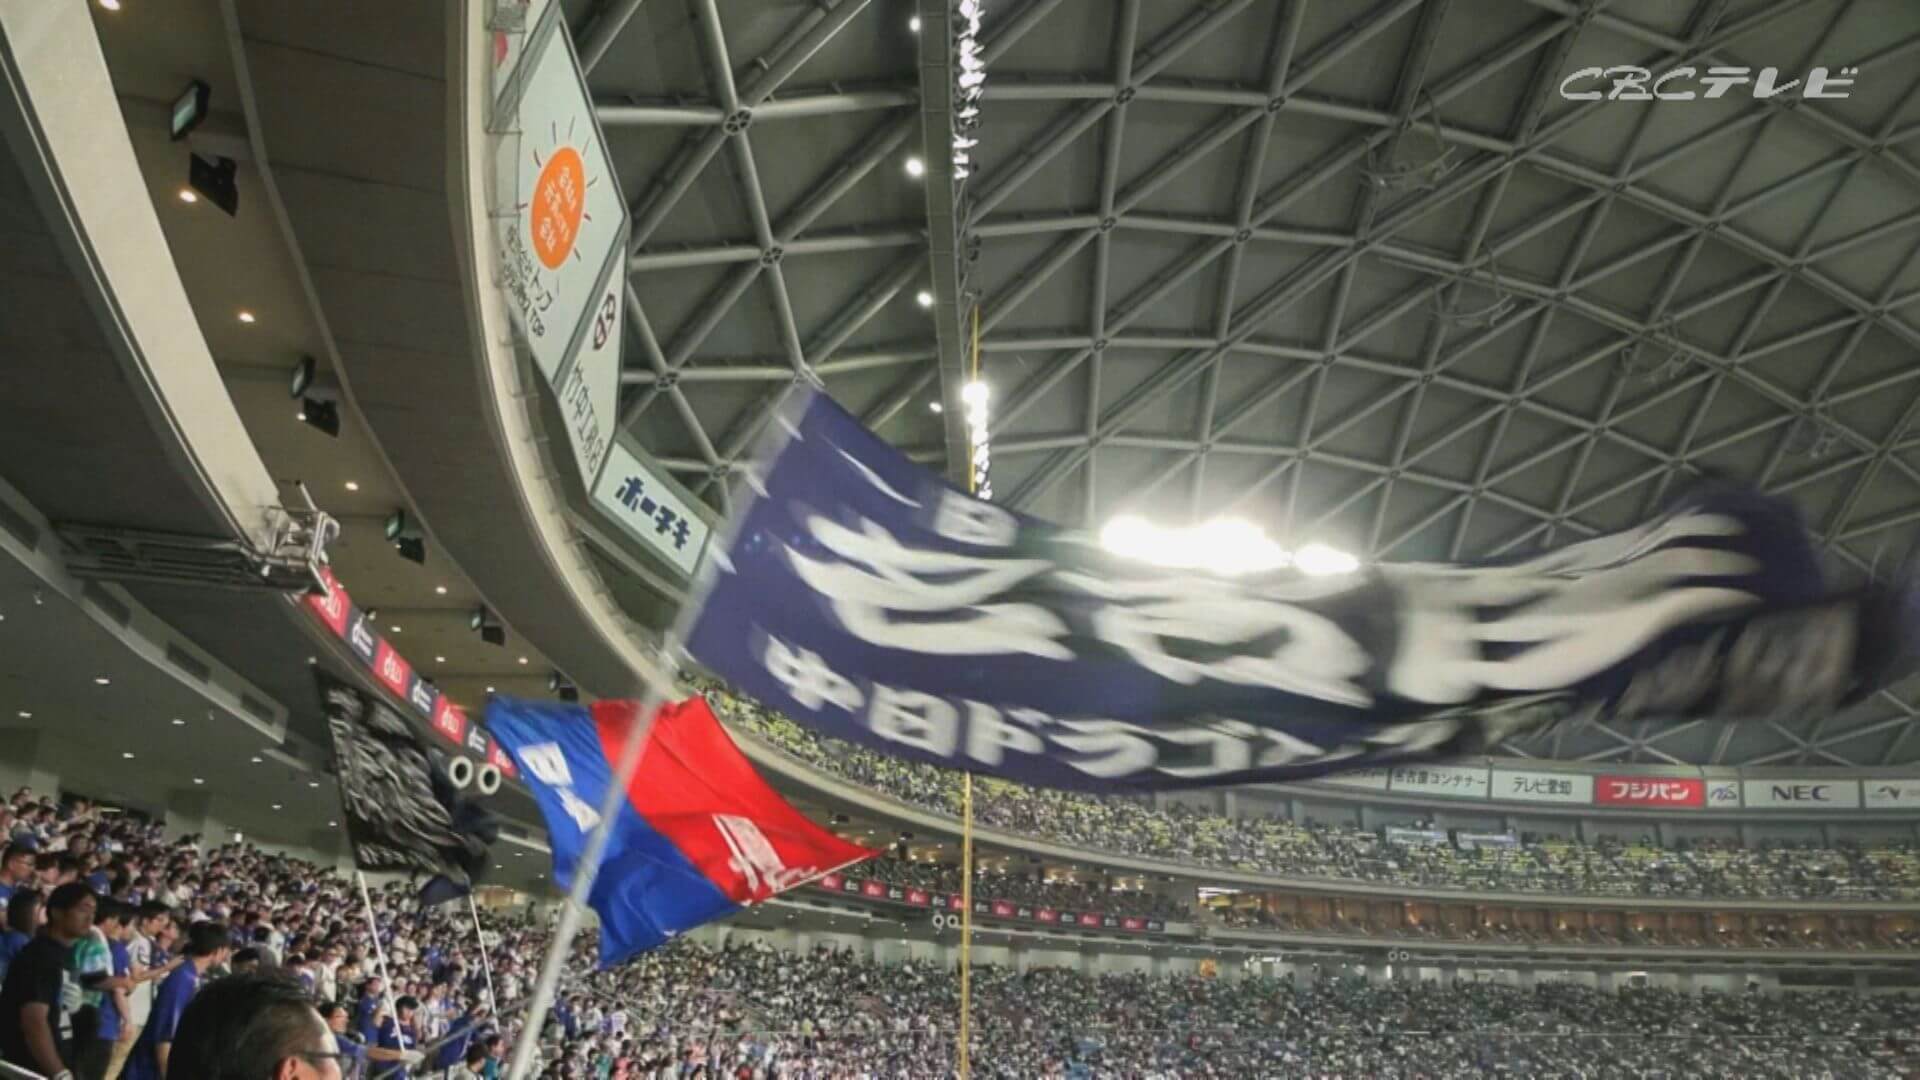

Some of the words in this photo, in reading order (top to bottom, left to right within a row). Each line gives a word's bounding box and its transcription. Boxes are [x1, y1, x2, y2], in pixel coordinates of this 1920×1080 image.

[615, 476, 691, 551] ホーチキ
[1512, 778, 1572, 797] テレビ愛知
[1610, 782, 1690, 800] フジパン
[1771, 784, 1833, 801] NEC
